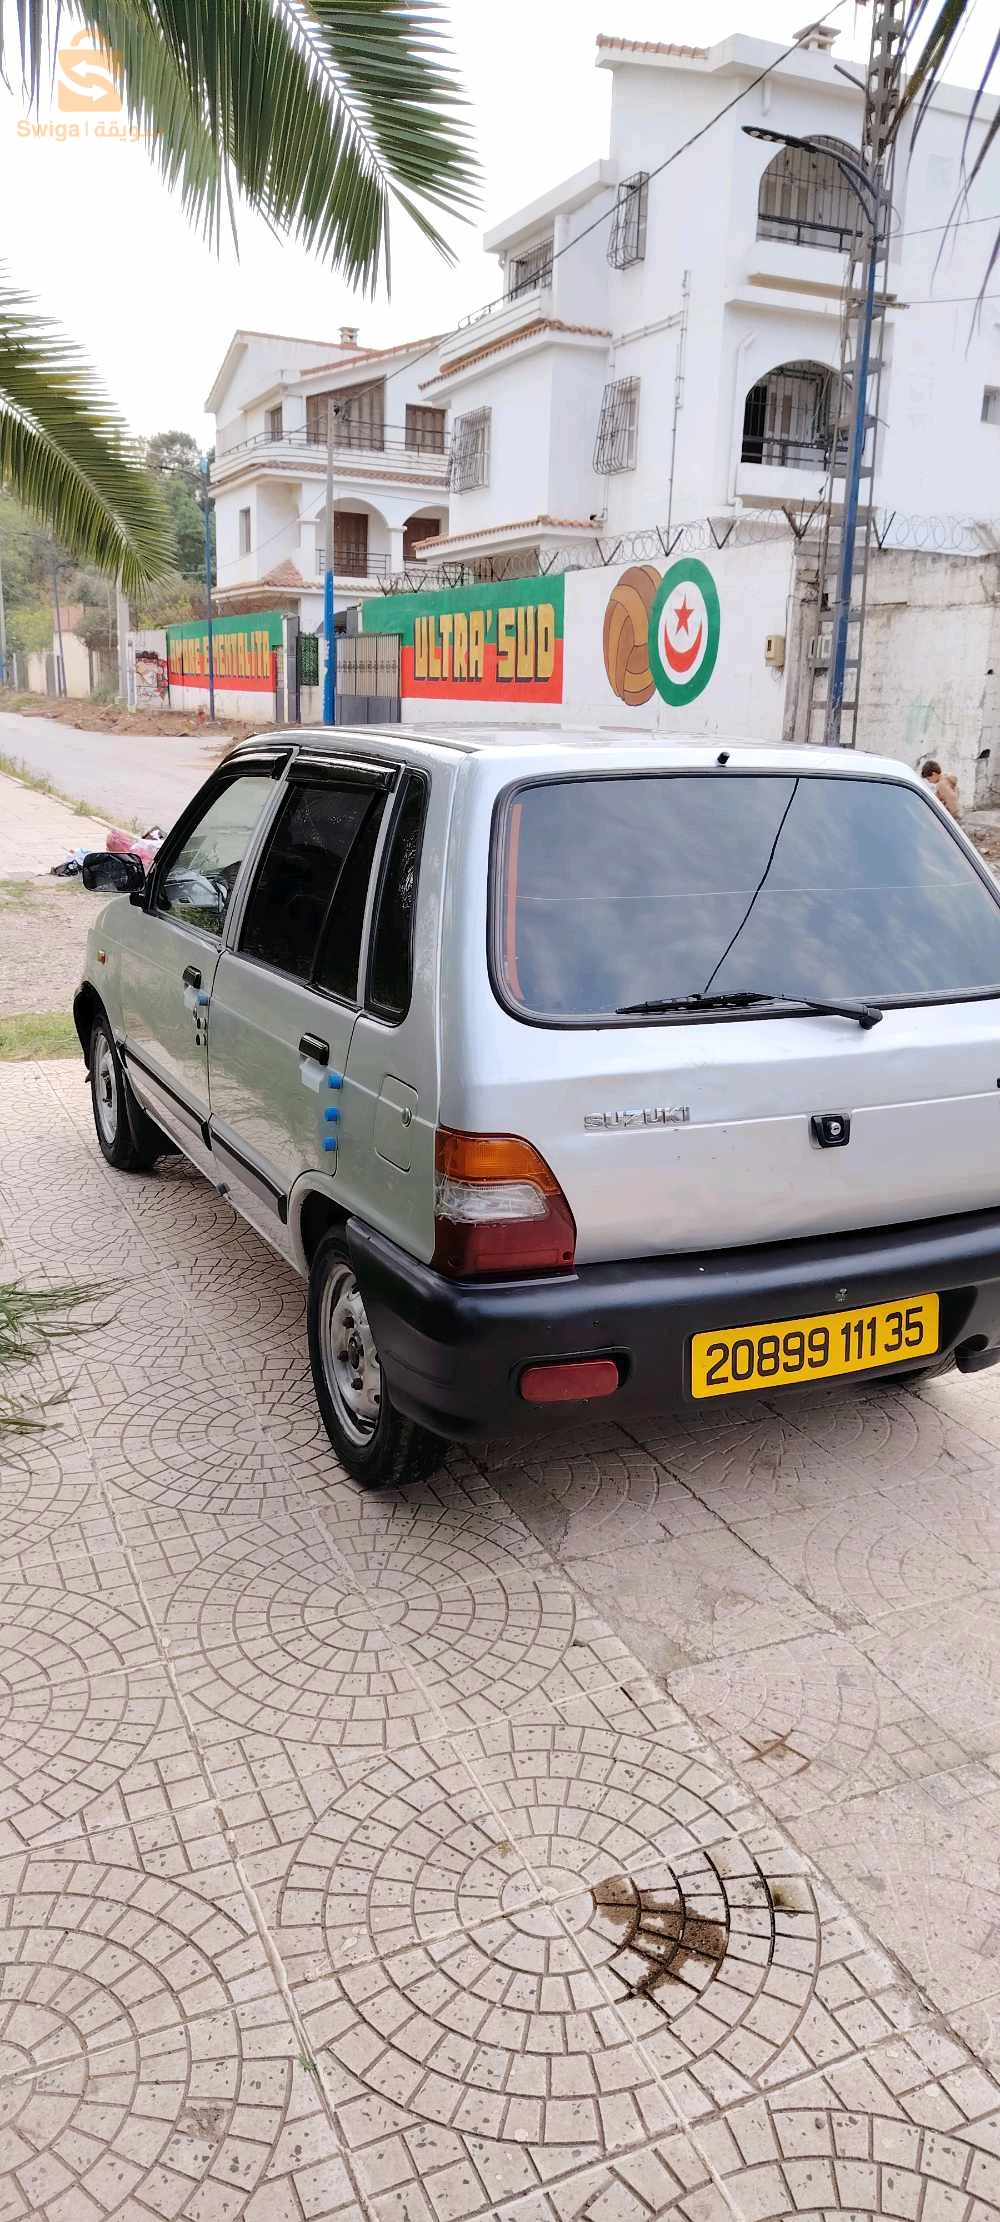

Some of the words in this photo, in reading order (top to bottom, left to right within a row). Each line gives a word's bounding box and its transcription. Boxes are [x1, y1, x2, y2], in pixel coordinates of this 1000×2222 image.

[583, 1104, 690, 1130] SUZUKI
[706, 1326, 830, 1386] 20899
[840, 1316, 878, 1362] 111
[884, 1306, 925, 1353] 35
